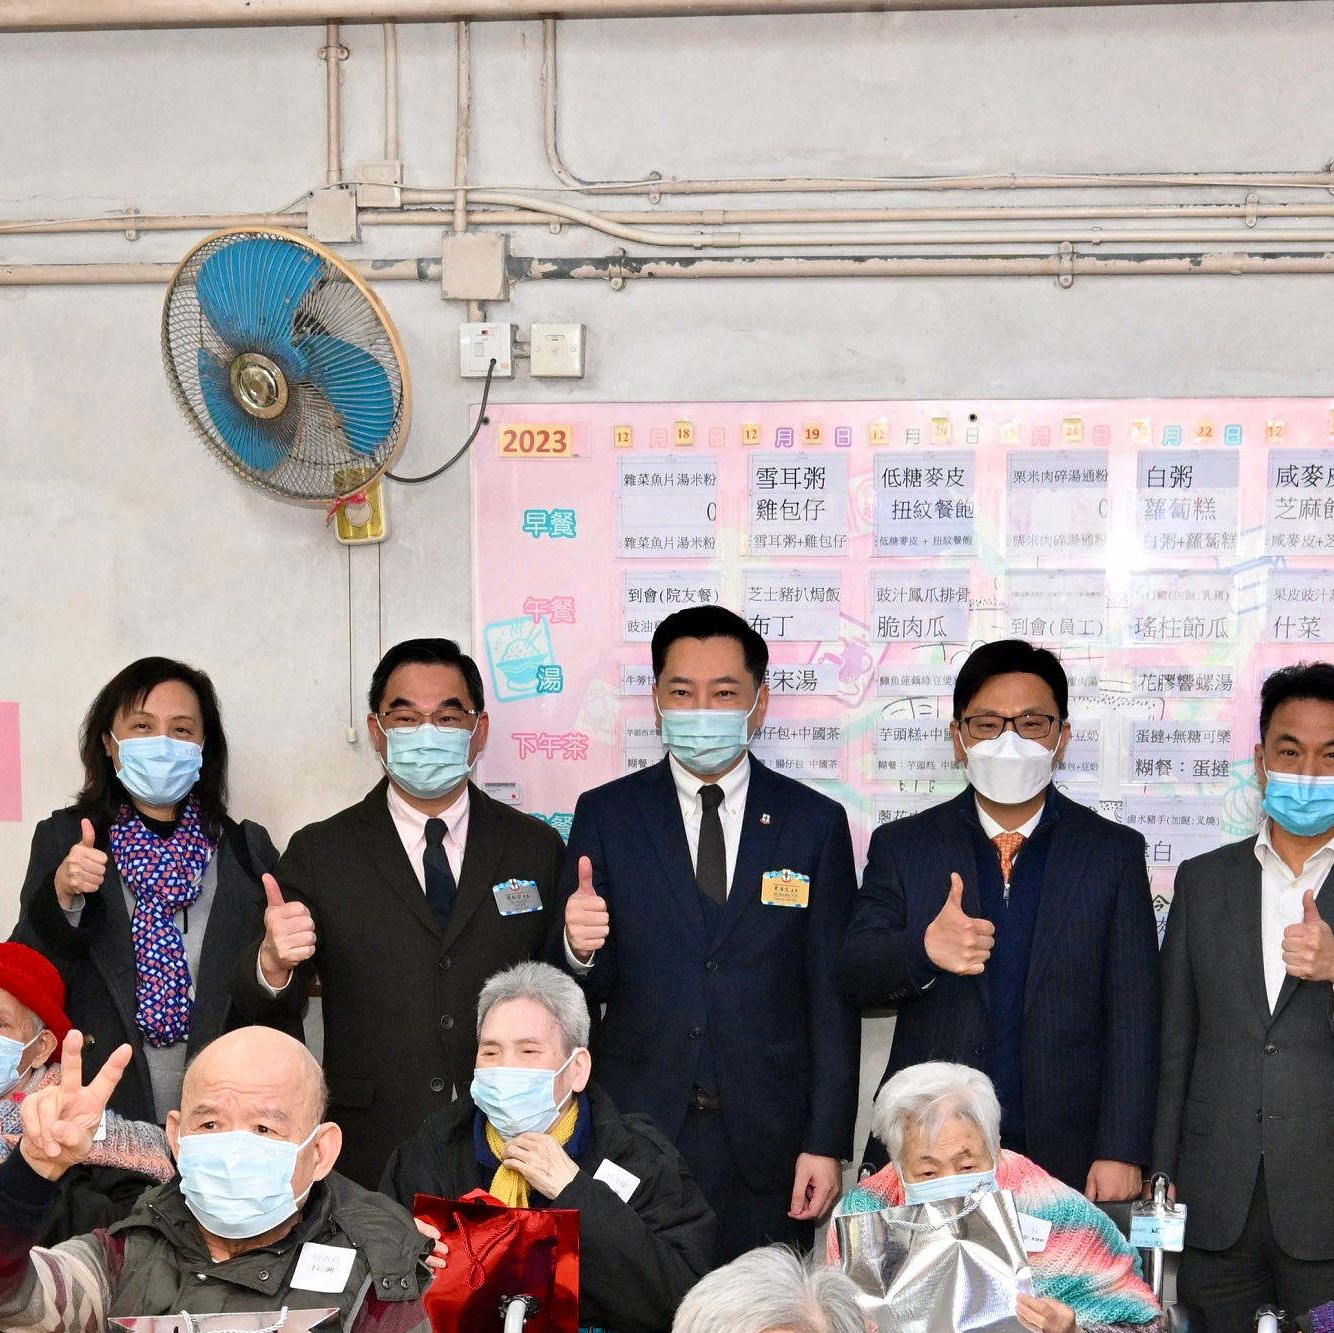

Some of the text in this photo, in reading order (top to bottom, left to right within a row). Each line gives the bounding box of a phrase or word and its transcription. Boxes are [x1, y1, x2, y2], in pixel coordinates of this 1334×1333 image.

[503, 429, 567, 453] 2023
[624, 473, 717, 487] 雜菜魚片湯米粉
[756, 467, 826, 490] 雪耳粥
[882, 467, 965, 488] 低糖麥皮
[1147, 465, 1194, 489] 白粥
[756, 498, 826, 522] 雞包仔
[1144, 497, 1217, 521] 蘿蔔糕
[523, 508, 577, 538] 早餐
[624, 536, 716, 550] 雜菜魚片湯米粉
[754, 534, 847, 549] 雪耳粥+雞包仔
[748, 587, 840, 602] 芝士豬扒焗飯
[523, 597, 577, 625] 午餐
[876, 616, 947, 638] 脆肉瓜
[1273, 615, 1321, 639] 什菜
[536, 664, 564, 694] 湯
[1138, 673, 1232, 692] 花膠響螺湯
[512, 733, 589, 760] 下午茶
[1136, 729, 1230, 744] 蛋撻+無糖可樂
